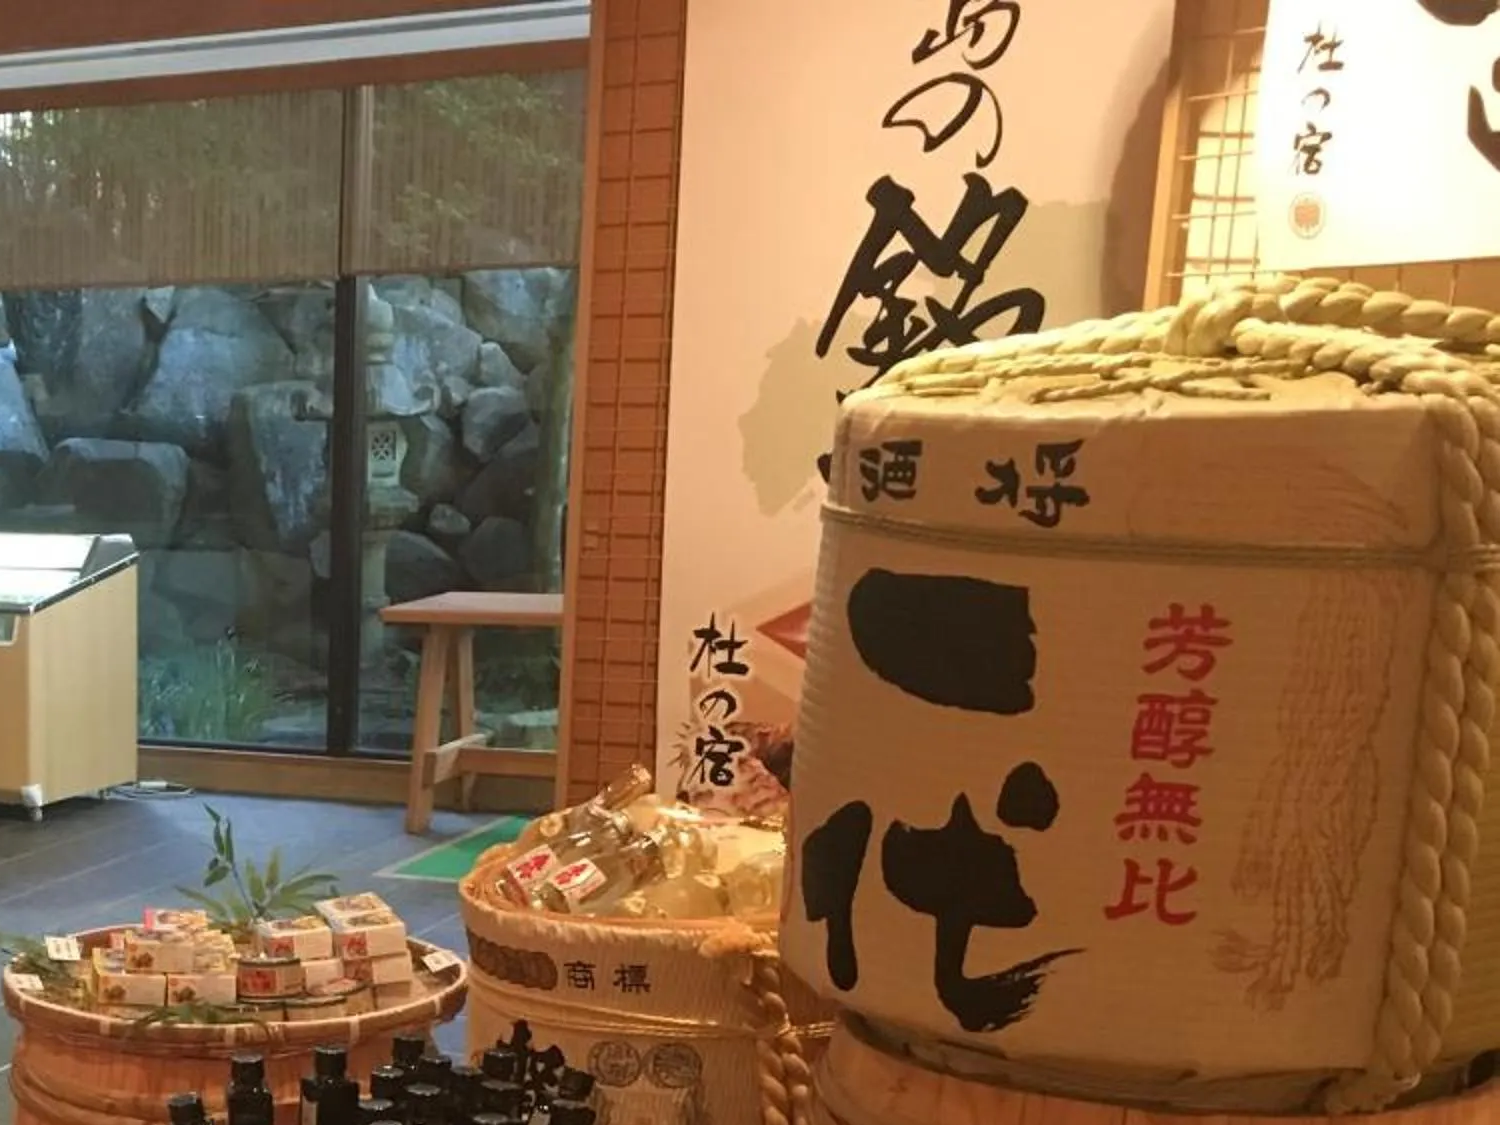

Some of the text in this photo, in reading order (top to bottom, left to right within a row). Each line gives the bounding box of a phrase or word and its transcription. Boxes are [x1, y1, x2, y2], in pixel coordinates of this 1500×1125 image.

[1292, 20, 1344, 177] 杜の宿
[813, 0, 1046, 420] 島の銘
[688, 611, 750, 787] 杜の宿
[1103, 602, 1234, 926] 芳醇無比
[563, 960, 651, 994] 商標
